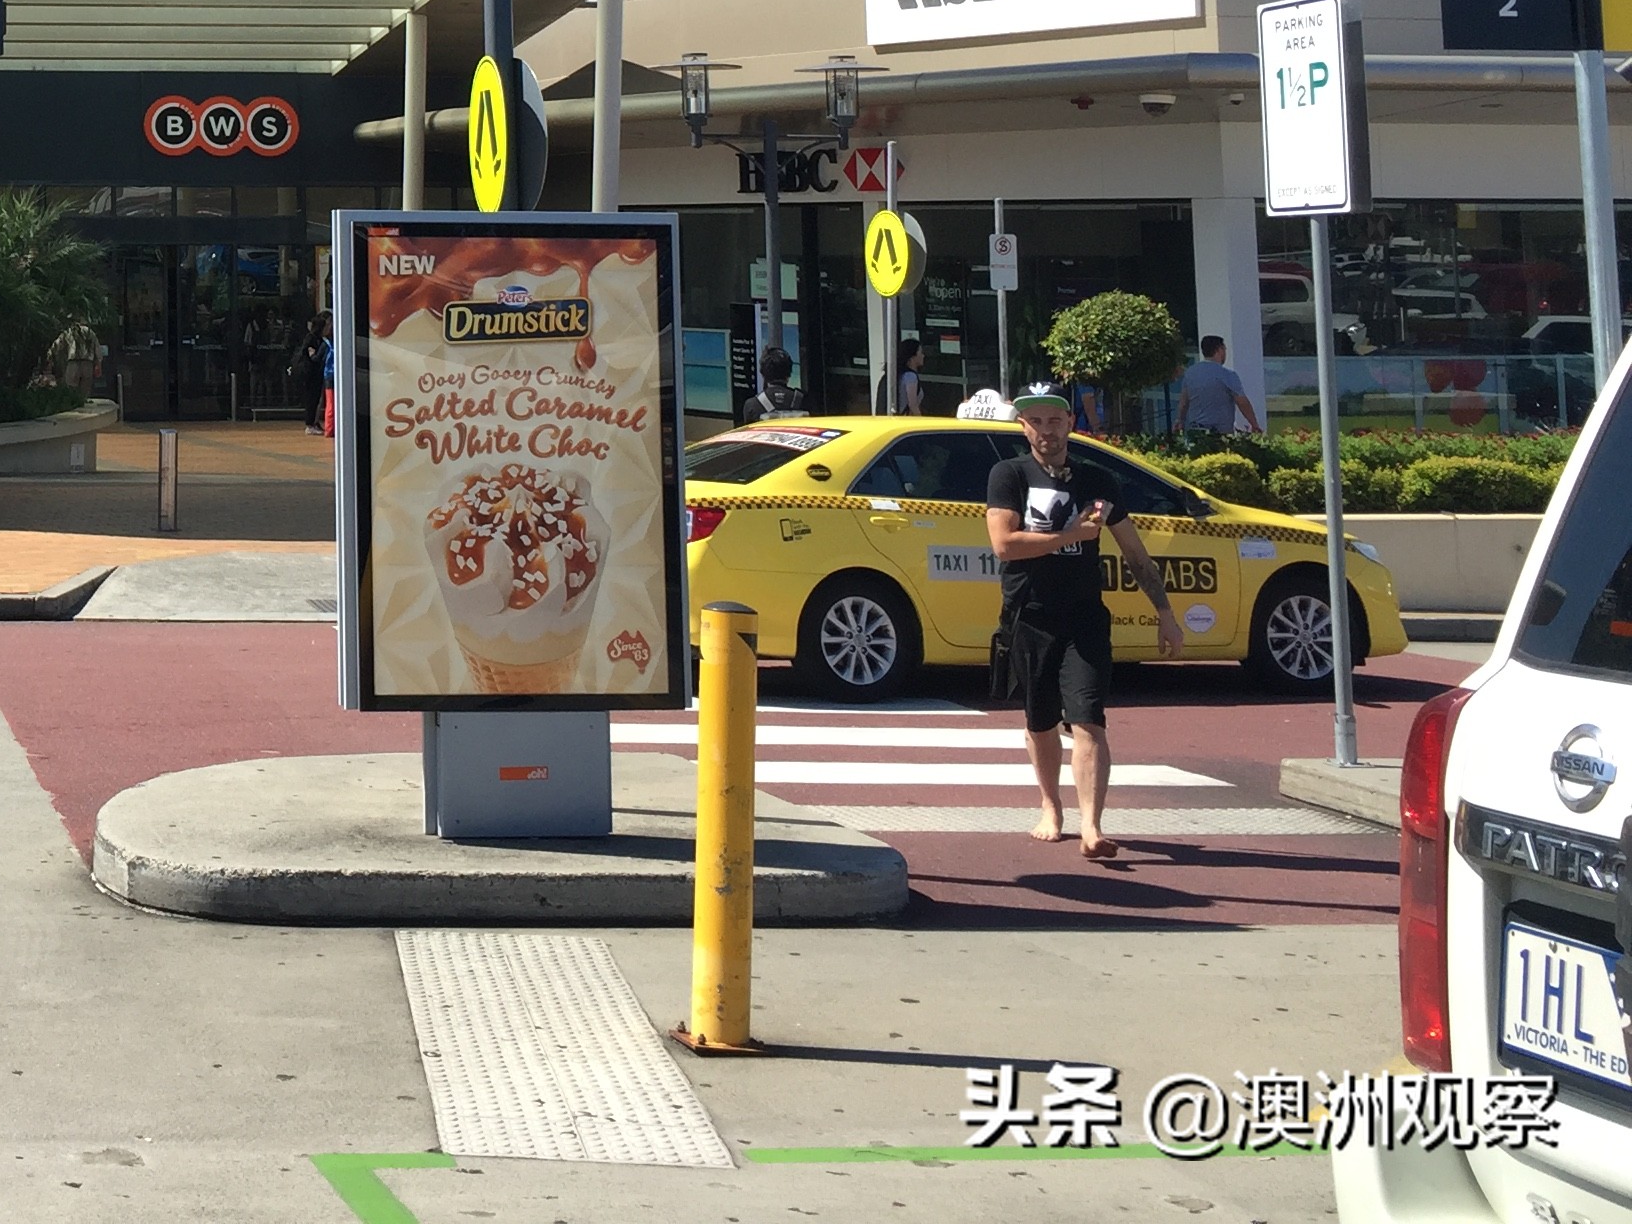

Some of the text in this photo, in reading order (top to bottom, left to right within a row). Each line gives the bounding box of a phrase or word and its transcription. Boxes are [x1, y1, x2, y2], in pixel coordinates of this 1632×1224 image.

[1274, 13, 1324, 33] PARKING
[1285, 35, 1316, 51] AREA
[736, 148, 839, 193] HBC
[378, 254, 436, 276] NEW
[448, 303, 587, 340] Drumstick
[417, 364, 617, 400] Ooey Gooey Crunchy
[384, 386, 648, 438] Salted Caramel
[414, 422, 611, 466] White Choc
[933, 552, 1002, 575] TAXI 11
[1150, 559, 1215, 591] ABS
[1110, 613, 1161, 626] lack Cab
[610, 638, 643, 659] Since
[1514, 1023, 1569, 1057] VICTORIA
[1582, 1045, 1607, 1069] THE
